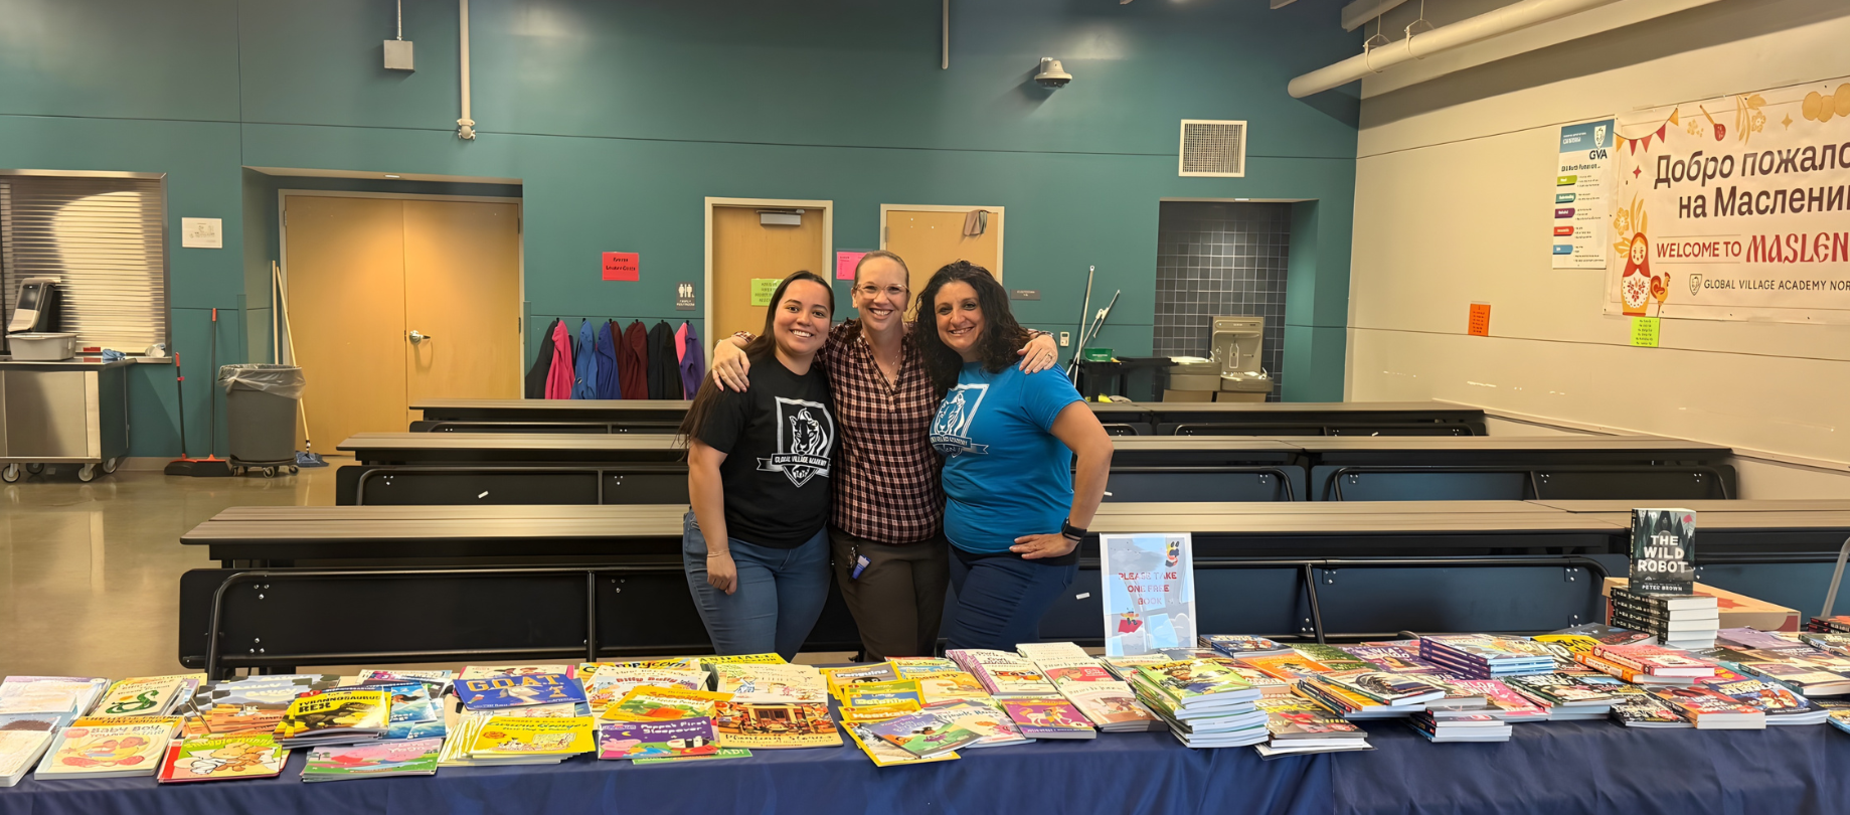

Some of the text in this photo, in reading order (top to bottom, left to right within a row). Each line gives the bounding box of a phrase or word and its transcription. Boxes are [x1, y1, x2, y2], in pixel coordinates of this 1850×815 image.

[1589, 149, 1608, 160] GVA
[1654, 150, 1734, 190] Добро
[1679, 185, 1850, 219] на Маслени
[1657, 241, 1720, 258] WELCOME
[1723, 240, 1742, 258] TO
[1704, 279, 1736, 290] GLOBAL
[1738, 280, 1775, 290] VILLAGE
[1778, 280, 1826, 291] ACADEMY
[809, 457, 827, 466] ACADEMY
[1650, 536, 1679, 546] THE
[1644, 547, 1684, 559] WILD
[1638, 560, 1688, 573] ROBOT
[1118, 572, 1177, 580] PLEASE TAKE
[1128, 584, 1170, 593] ONE FREE
[836, 669, 889, 678] Penguins
[466, 674, 564, 692] G.O.A.T.
[299, 703, 331, 713] REX
